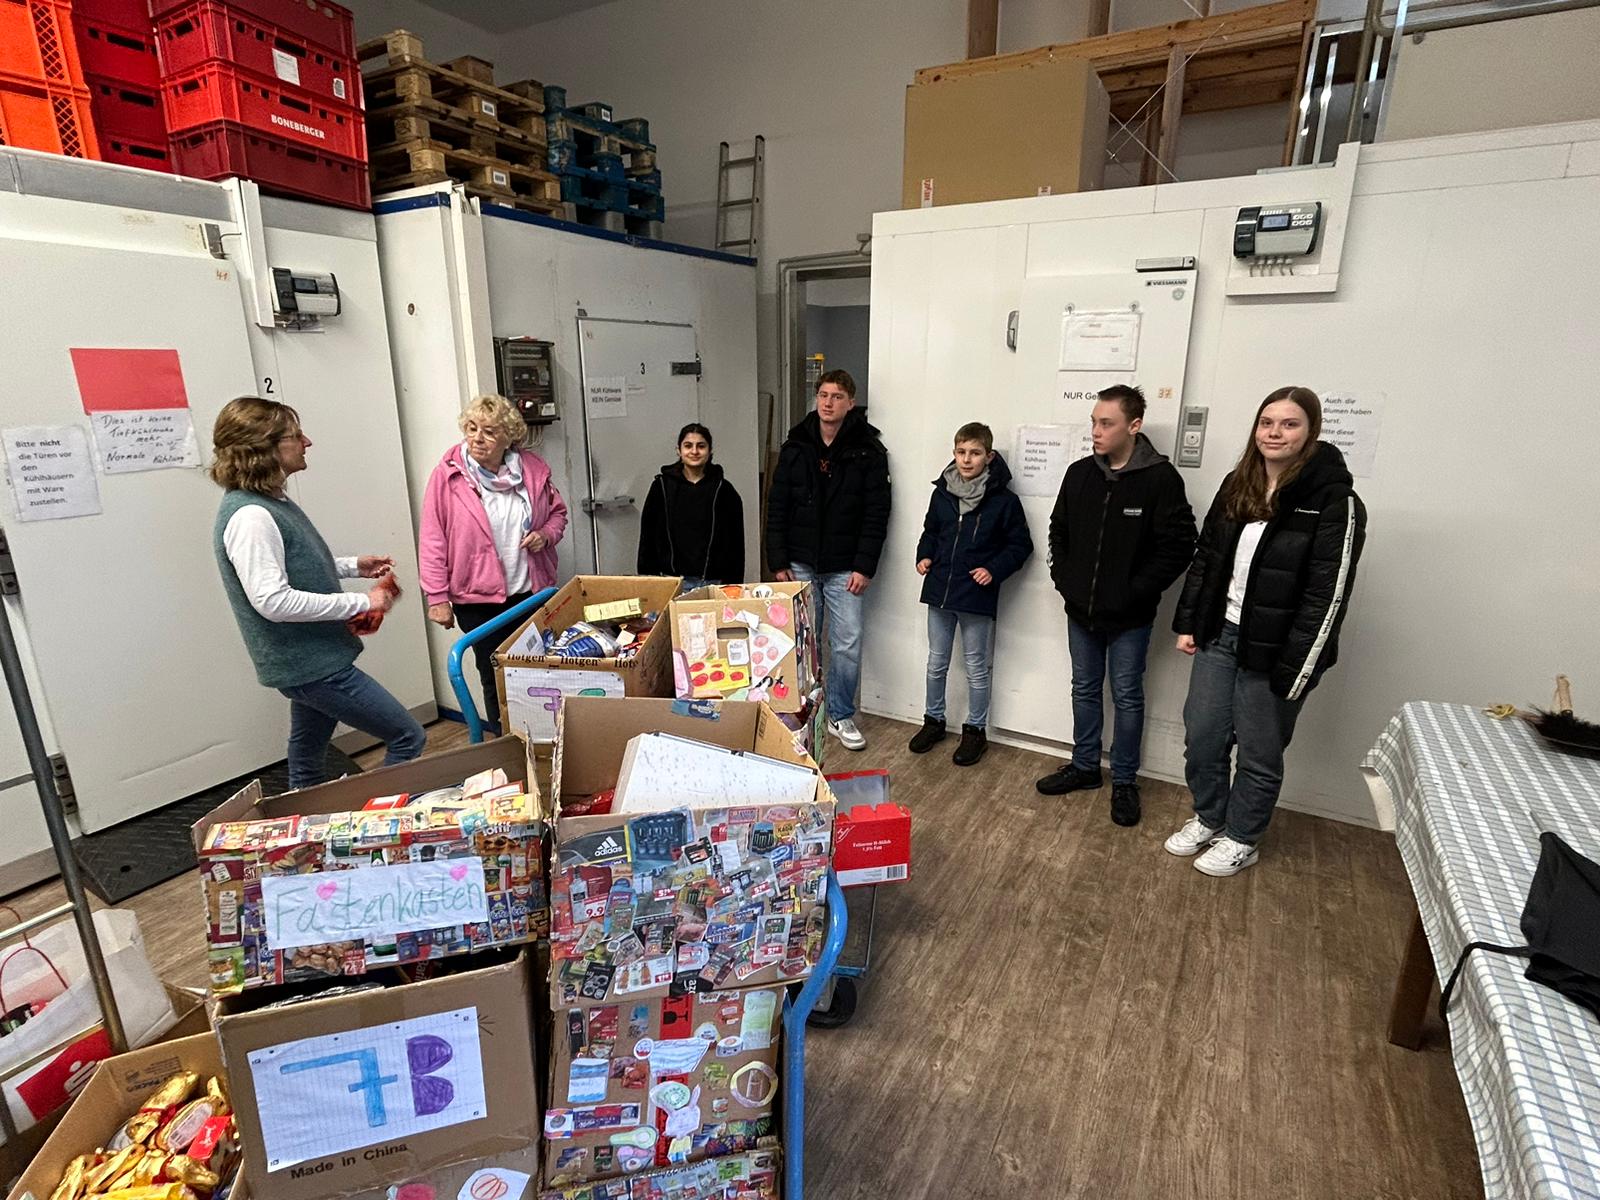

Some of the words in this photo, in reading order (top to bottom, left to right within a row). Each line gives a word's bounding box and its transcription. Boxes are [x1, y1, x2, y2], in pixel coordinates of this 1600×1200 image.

[271, 114, 325, 139] BONEBERGER
[640, 362, 646, 375] 3
[264, 377, 275, 393] 2
[1063, 391, 1083, 400] NUR
[1085, 391, 1100, 400] Ge
[39, 439, 61, 447] nicht
[18, 453, 32, 461] die
[106, 450, 145, 462] Normale
[23, 473, 75, 482] Kühlhäusern
[26, 487, 41, 495] mit
[594, 845, 623, 857] adidas
[276, 875, 484, 940] Fastenkasten
[280, 1033, 455, 1128] 7B
[290, 1158, 334, 1180] Made
[341, 1154, 356, 1166] in
[363, 1141, 408, 1161] China
